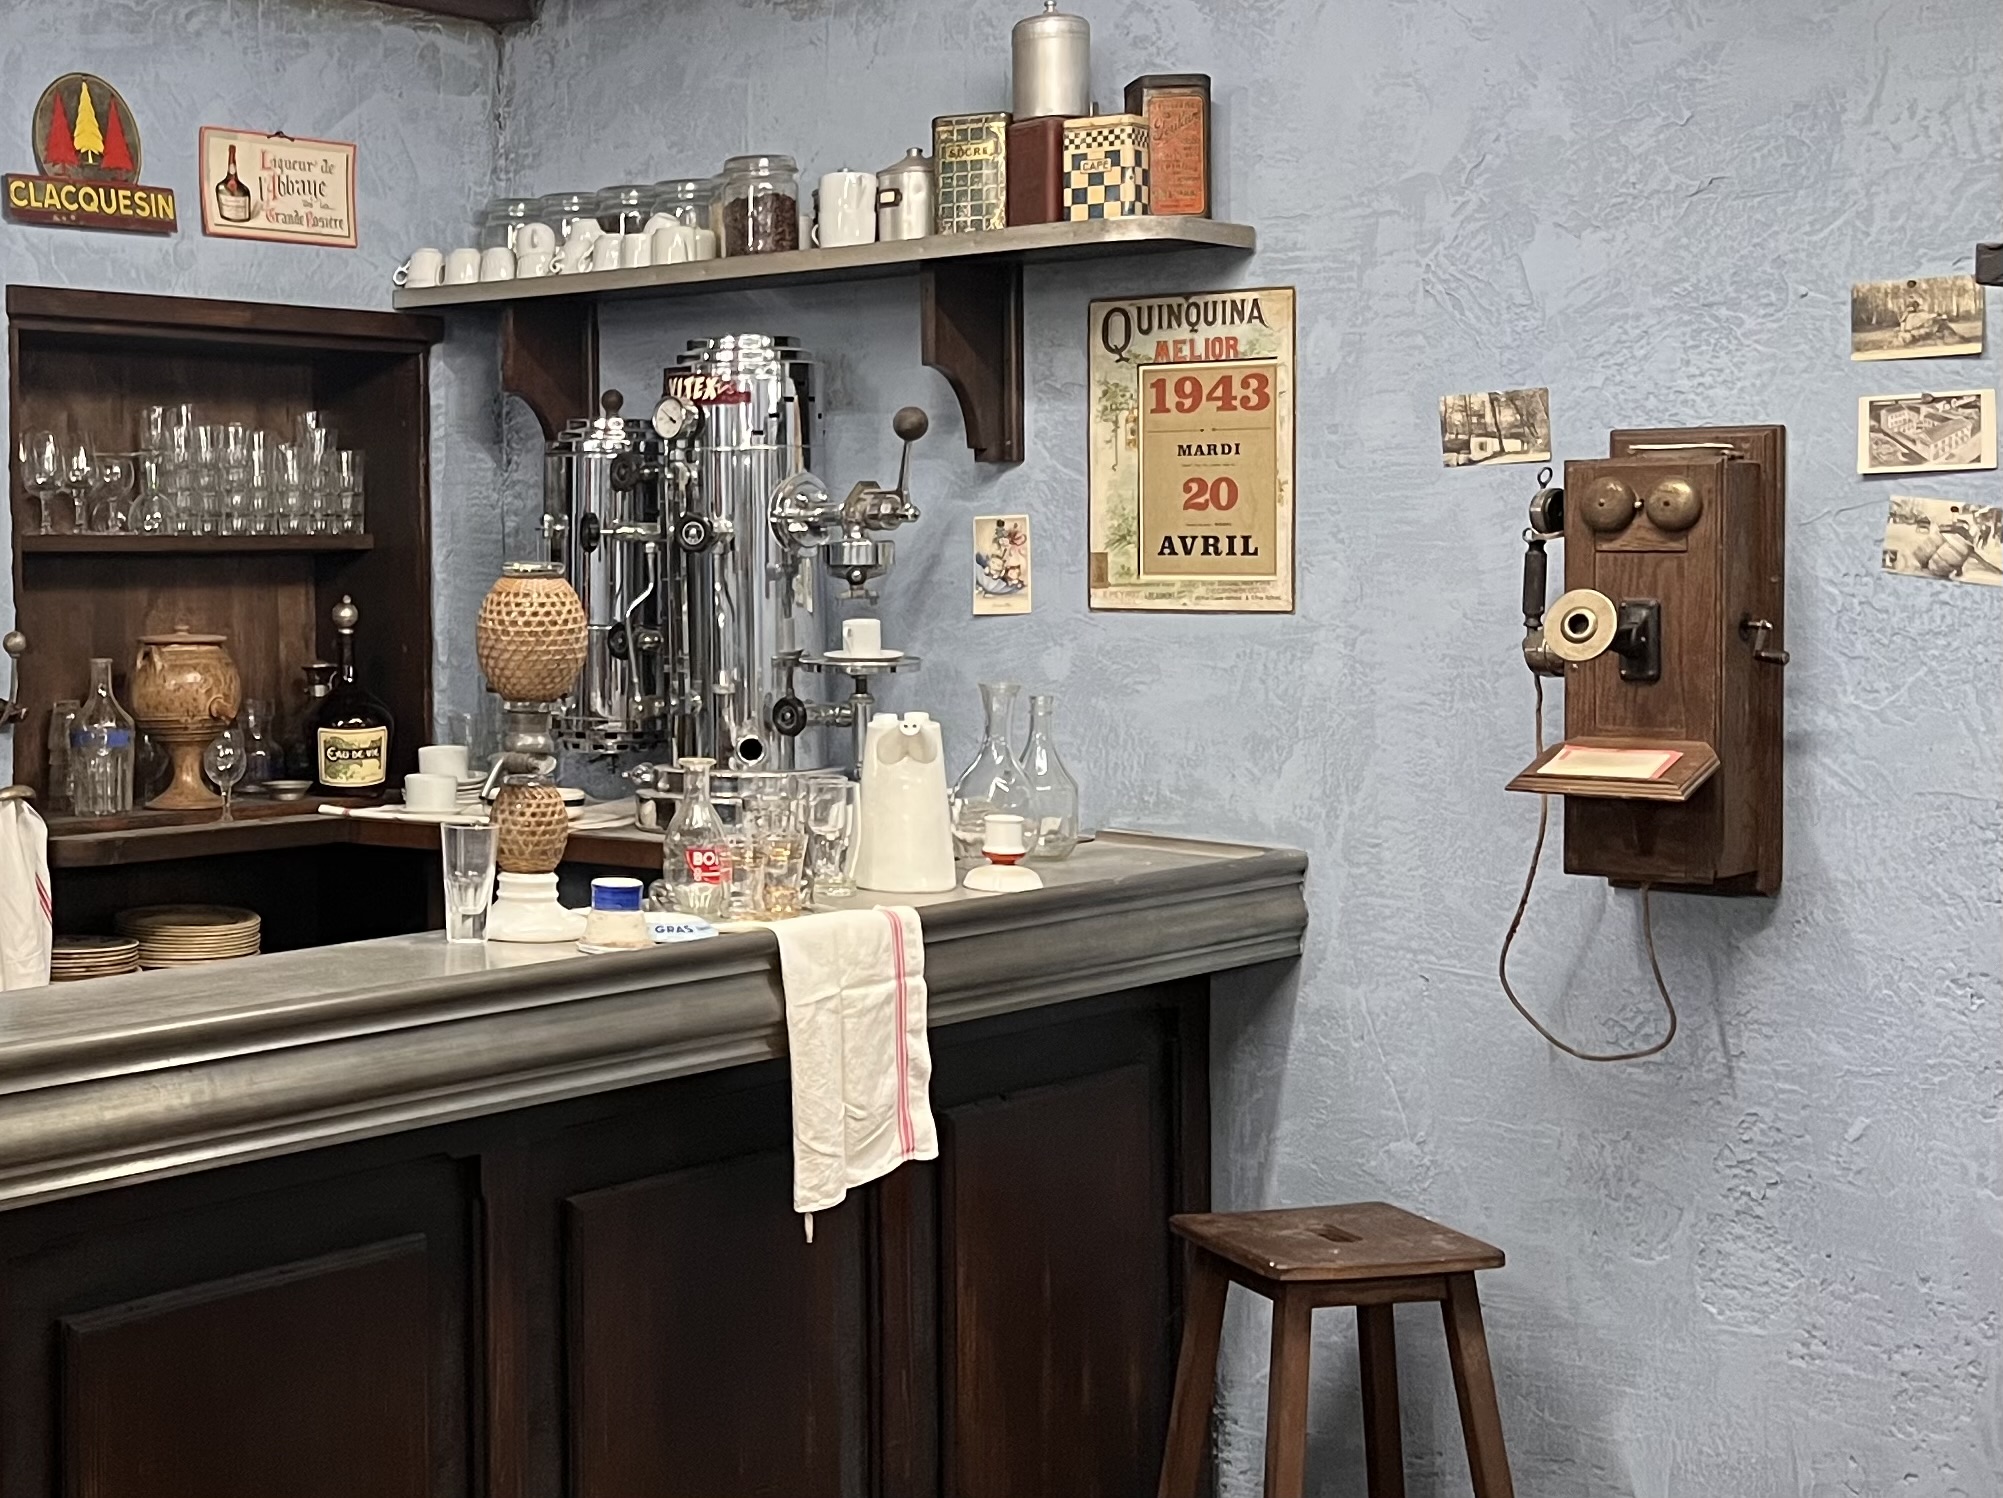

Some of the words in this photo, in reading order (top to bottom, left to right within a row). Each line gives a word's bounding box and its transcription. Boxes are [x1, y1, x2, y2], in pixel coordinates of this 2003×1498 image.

[261, 150, 317, 174] Liqueur
[320, 158, 335, 175] de
[9, 180, 175, 220] CLACQUESIN
[266, 207, 304, 226] Grande
[1102, 298, 1270, 363] QUINQUINA
[1154, 336, 1239, 363] MELIOR
[668, 376, 719, 400] VITEX
[1149, 372, 1271, 414] 1943
[1177, 442, 1241, 457] MARDI
[1182, 476, 1239, 511] 20
[1157, 534, 1259, 556] AVRIL
[655, 925, 694, 933] GRAS
